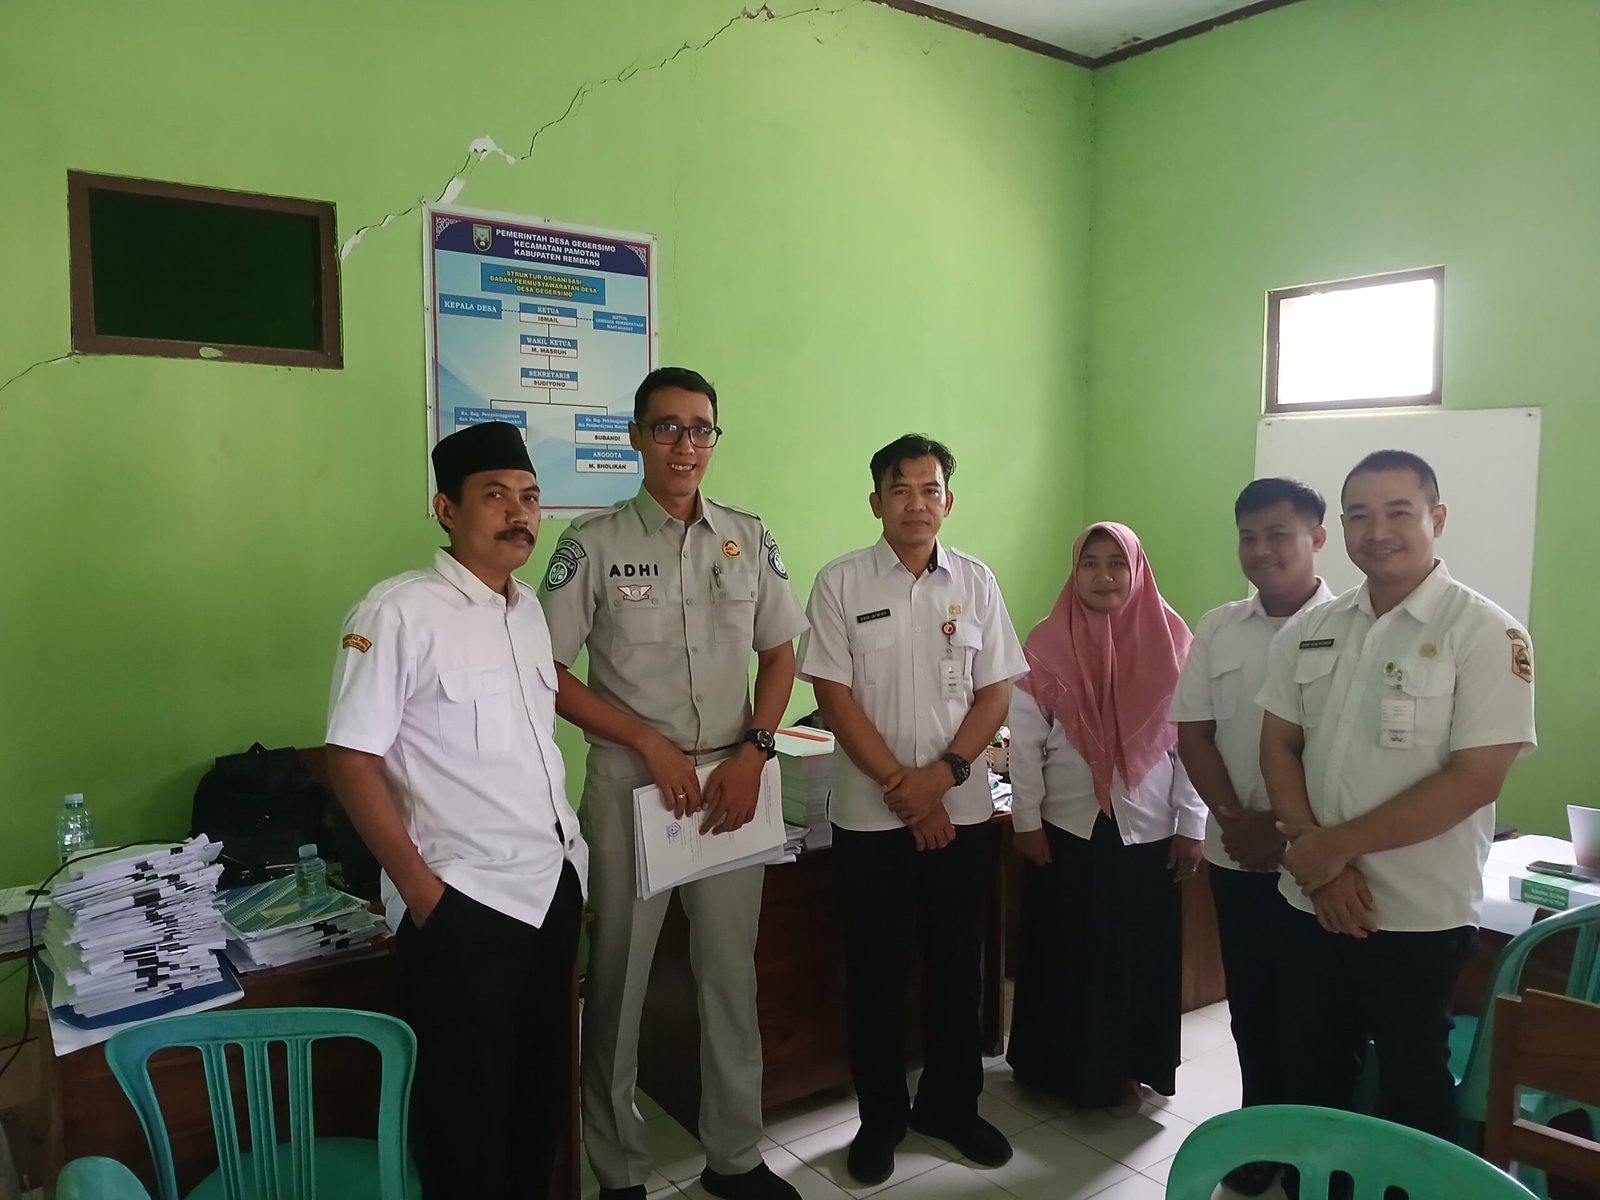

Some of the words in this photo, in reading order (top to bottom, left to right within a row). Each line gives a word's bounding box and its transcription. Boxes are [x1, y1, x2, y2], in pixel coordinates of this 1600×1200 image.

[496, 229, 547, 243] PEMERINTAH
[549, 236, 570, 246] DESA
[572, 240, 616, 253] GEGERSIMO
[514, 240, 563, 253] KECAMATAN
[564, 247, 600, 259] PAMOTAN
[514, 248, 561, 261] KABUPATEN
[563, 255, 600, 267] REMBANG
[490, 275, 513, 284] BADAN
[514, 278, 580, 291] PERMUSYAWARATAN
[506, 270, 542, 280] STRUKTUR
[543, 275, 582, 285] ORGANISASI
[535, 288, 573, 298] GEGERSIMO
[444, 300, 475, 310] KEPALA
[477, 304, 497, 313] DESA
[537, 306, 560, 315] KETUA
[538, 316, 559, 324] ISMAIL
[526, 337, 548, 345] WAKIL
[528, 370, 570, 379] SEKRETARIS
[609, 563, 659, 578] ADHI
